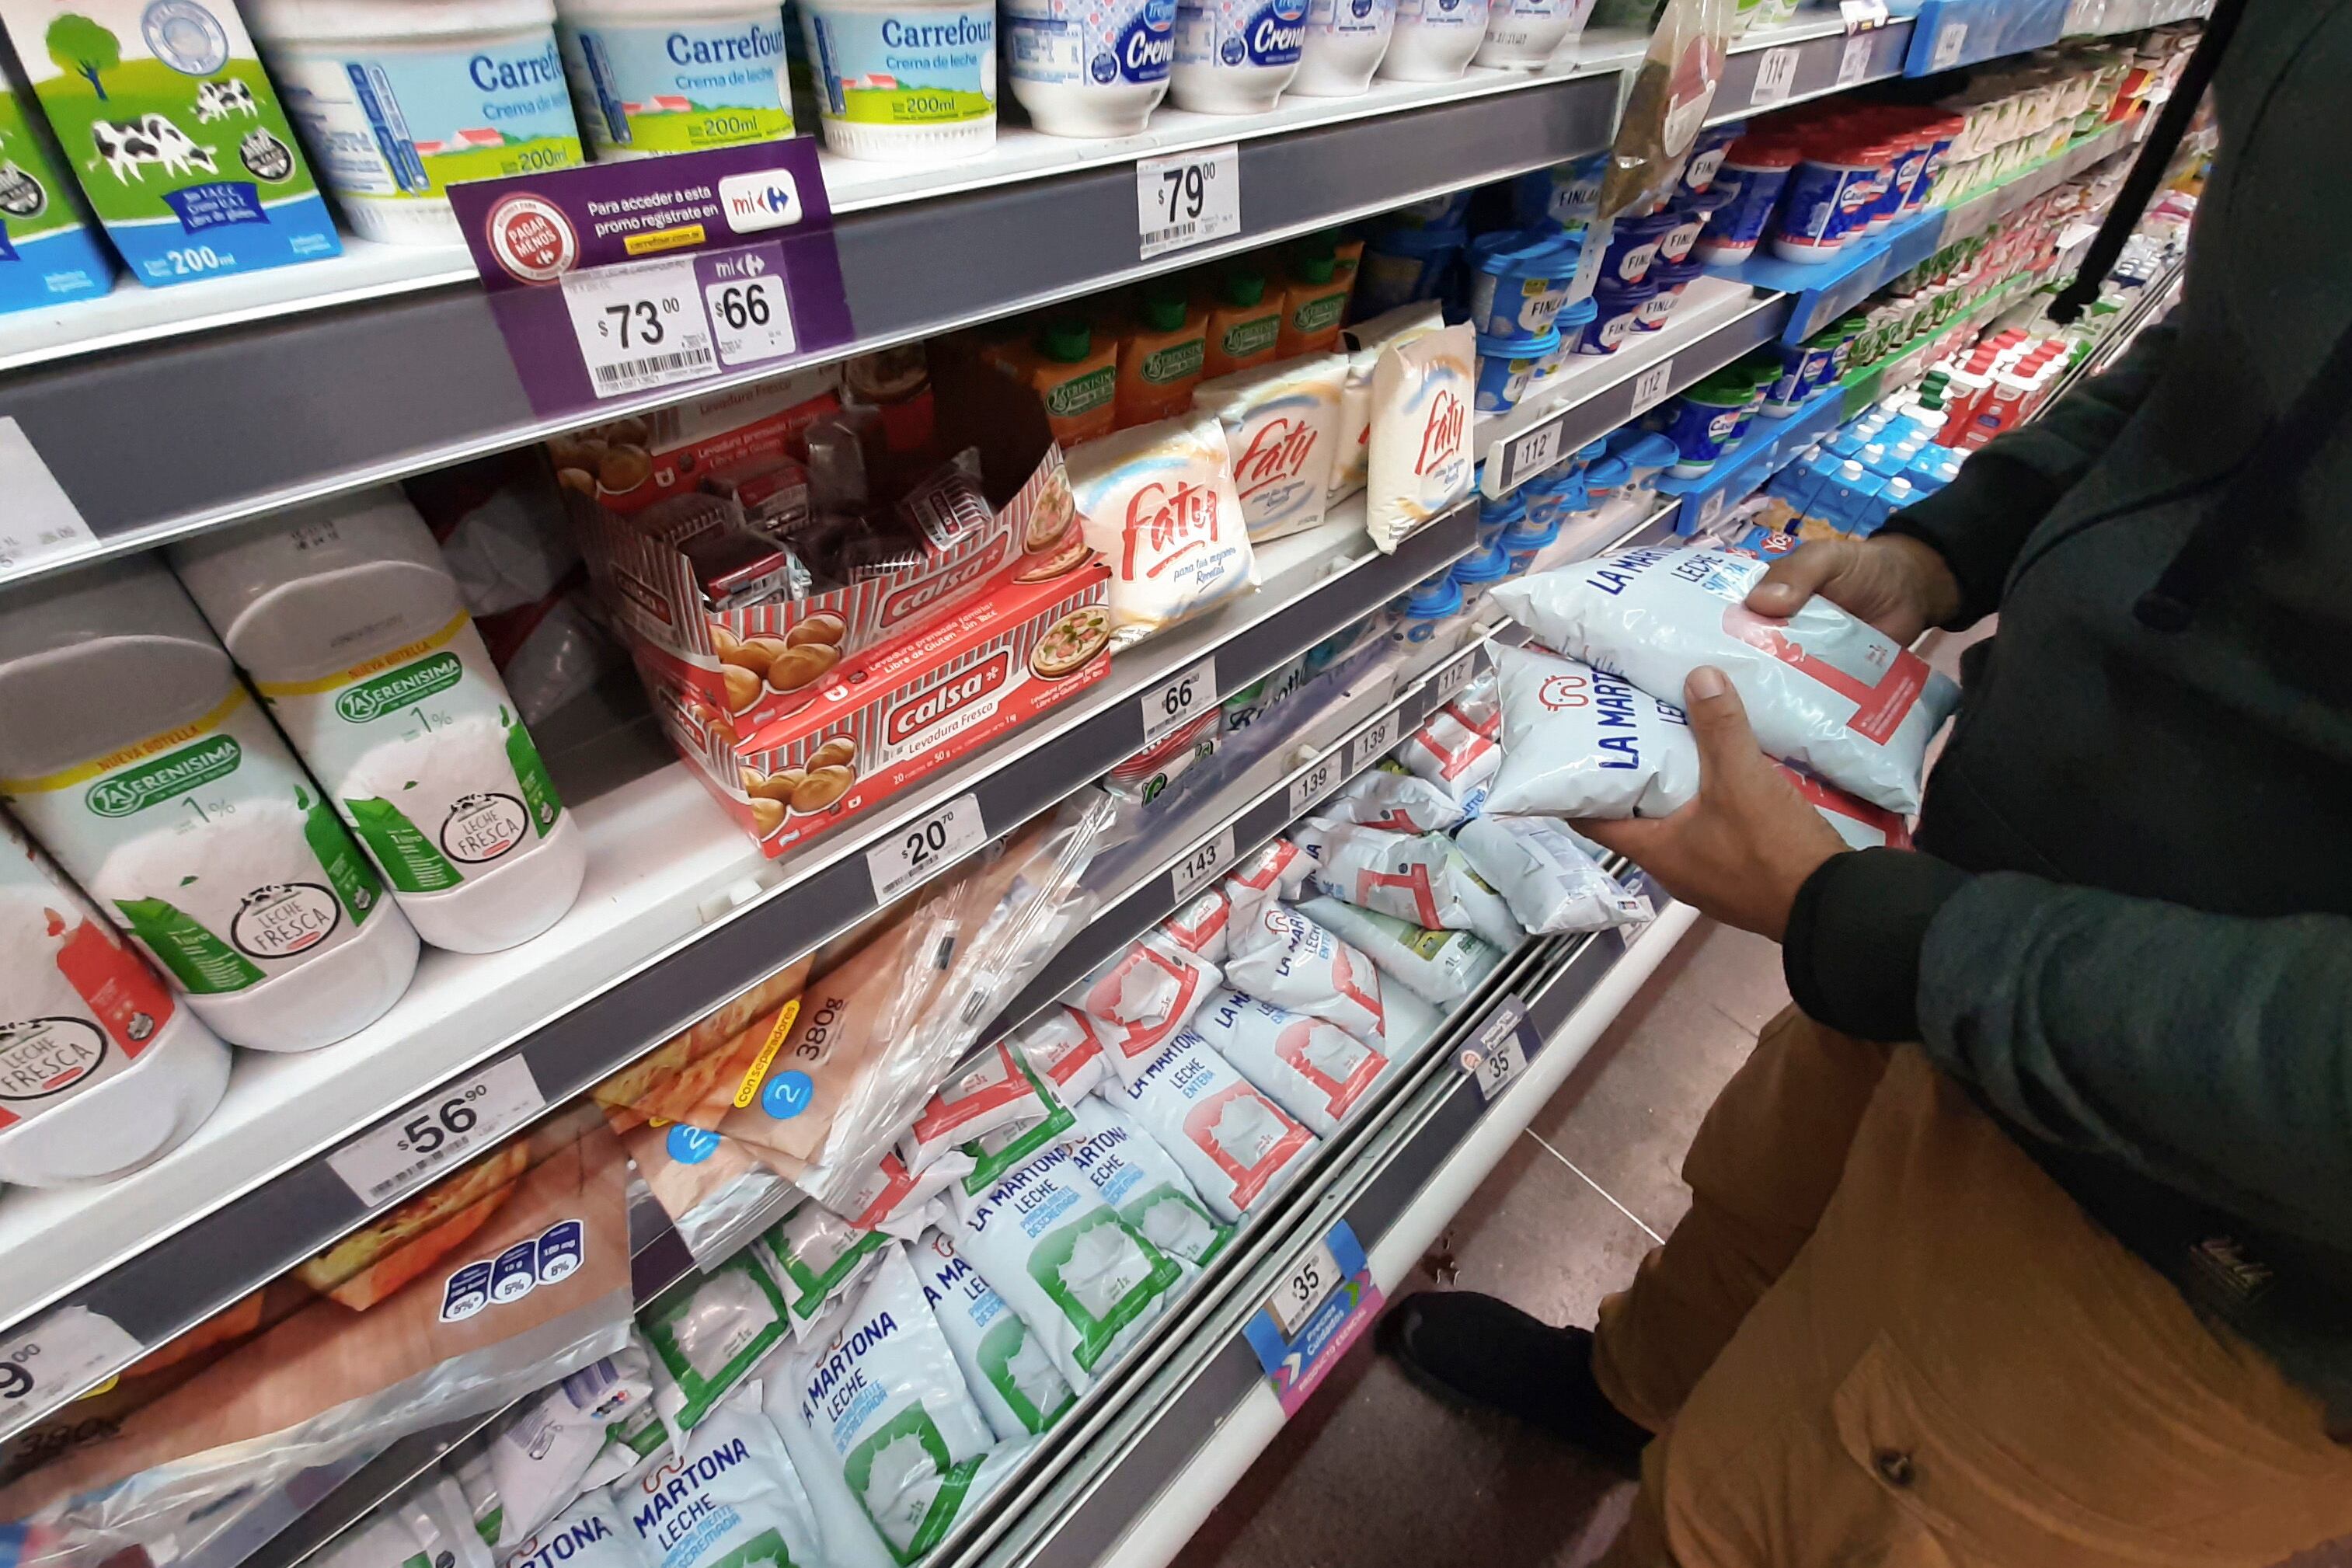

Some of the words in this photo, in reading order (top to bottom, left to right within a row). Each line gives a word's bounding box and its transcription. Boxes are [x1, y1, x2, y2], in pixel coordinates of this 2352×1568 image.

[665, 23, 783, 68] Carrefour
[881, 14, 993, 50] Carrefour
[1126, 30, 1175, 69] Crem
[469, 44, 563, 93] Carref
[885, 54, 932, 71] Crema
[932, 54, 949, 69] de
[674, 74, 726, 91] Crema
[727, 70, 744, 86] de
[482, 101, 535, 120] Crema
[905, 97, 956, 113] 200ml
[703, 116, 758, 137] 200ml
[517, 148, 568, 172] 200ml
[587, 200, 619, 217] Para
[621, 192, 673, 211] acceder
[675, 190, 683, 203] a
[684, 186, 713, 200] esta
[507, 215, 548, 244] PAGAR
[594, 215, 640, 238] promo
[702, 204, 720, 218] en
[514, 229, 557, 258] MENOS
[1121, 479, 1218, 582] Faty
[1586, 571, 1627, 596] LA
[1671, 553, 1725, 583] LECHE
[891, 556, 984, 618] calsa
[869, 644, 915, 671] Levadura
[883, 655, 911, 674] Libre
[912, 648, 925, 660] de
[925, 632, 957, 652] Gluten
[960, 619, 978, 632] Sin
[897, 673, 984, 737] calsa
[1591, 671, 1635, 727] MART
[908, 719, 959, 754] Levadura
[960, 701, 995, 727] Fresca
[98, 744, 141, 772] NUEVA
[1598, 736, 1640, 770] LA
[458, 817, 520, 855] FRESCA
[463, 809, 499, 835] LECHE
[253, 908, 330, 953] FRESCA
[257, 900, 304, 929] LECHE
[796, 997, 845, 1061] 380g
[1, 1042, 95, 1092] FRESCA
[2, 1037, 58, 1068] LECHE
[737, 1078, 758, 1103] con
[750, 1005, 796, 1078] separadores
[1127, 1078, 1149, 1100] LA
[1169, 1057, 1206, 1091] LECHE
[1182, 1069, 1217, 1099] ENTERA
[774, 1083, 801, 1104] 2
[1072, 1125, 1131, 1172] ARTONA
[989, 1144, 1071, 1207] MARTONA
[1089, 1154, 1125, 1189] ECHE
[1013, 1178, 1059, 1215] LECHE
[807, 1311, 900, 1402] MARTONA
[827, 1367, 869, 1424] LECHE
[632, 1437, 751, 1540] MARTONA
[657, 1492, 717, 1552] LECHE
